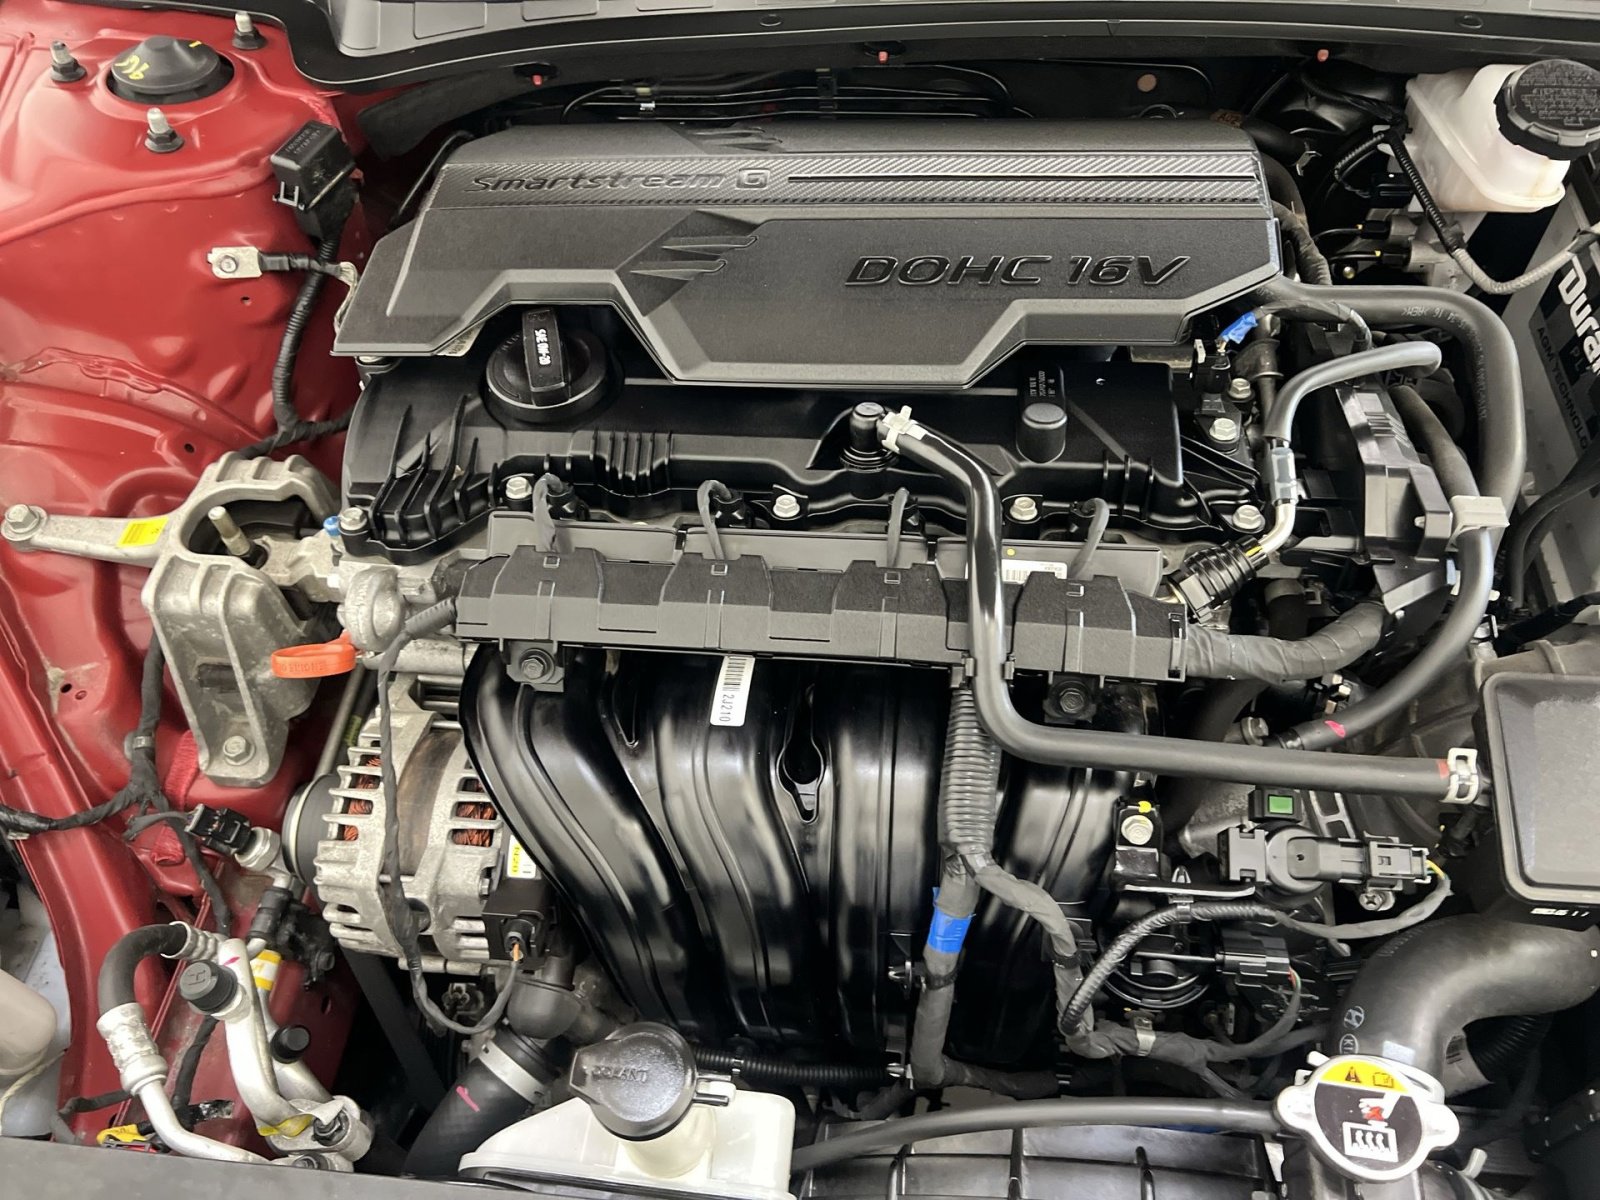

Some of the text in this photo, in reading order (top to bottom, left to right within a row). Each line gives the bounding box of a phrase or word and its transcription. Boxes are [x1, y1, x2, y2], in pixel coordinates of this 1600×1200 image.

[464, 171, 726, 192] Smartstream
[845, 255, 1192, 286] DOHC 16V
[1558, 254, 1600, 377] Dura
[1537, 326, 1554, 363] AGM
